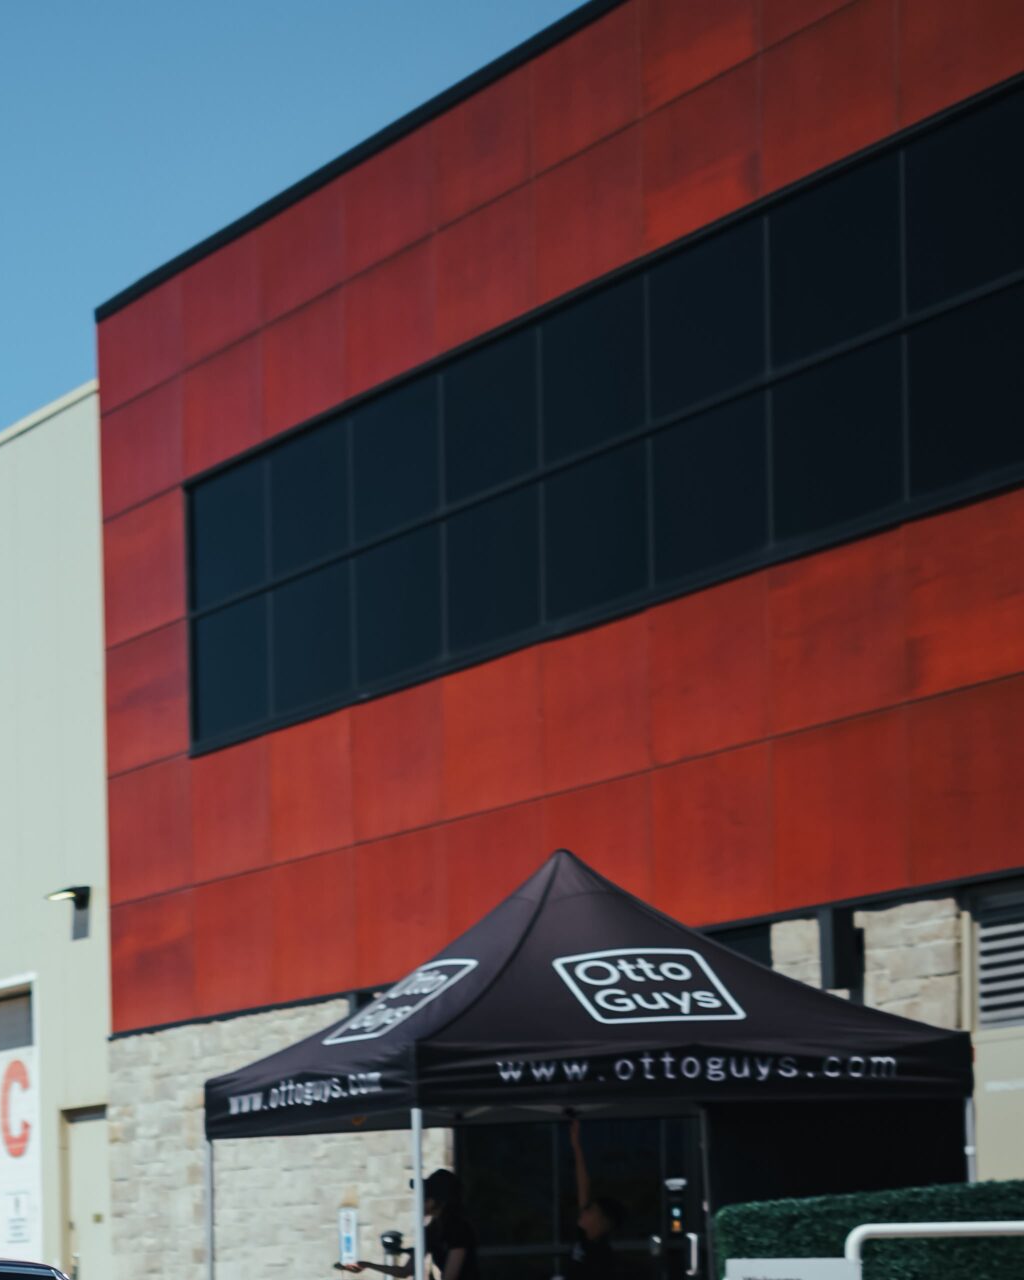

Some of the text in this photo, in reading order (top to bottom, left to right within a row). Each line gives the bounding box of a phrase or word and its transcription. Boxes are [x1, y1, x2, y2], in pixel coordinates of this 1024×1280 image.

[574, 957, 692, 987] Otto
[594, 988, 722, 1015] Guys
[496, 1052, 898, 1082] www.ottoguys.com
[0, 1060, 31, 1158] C
